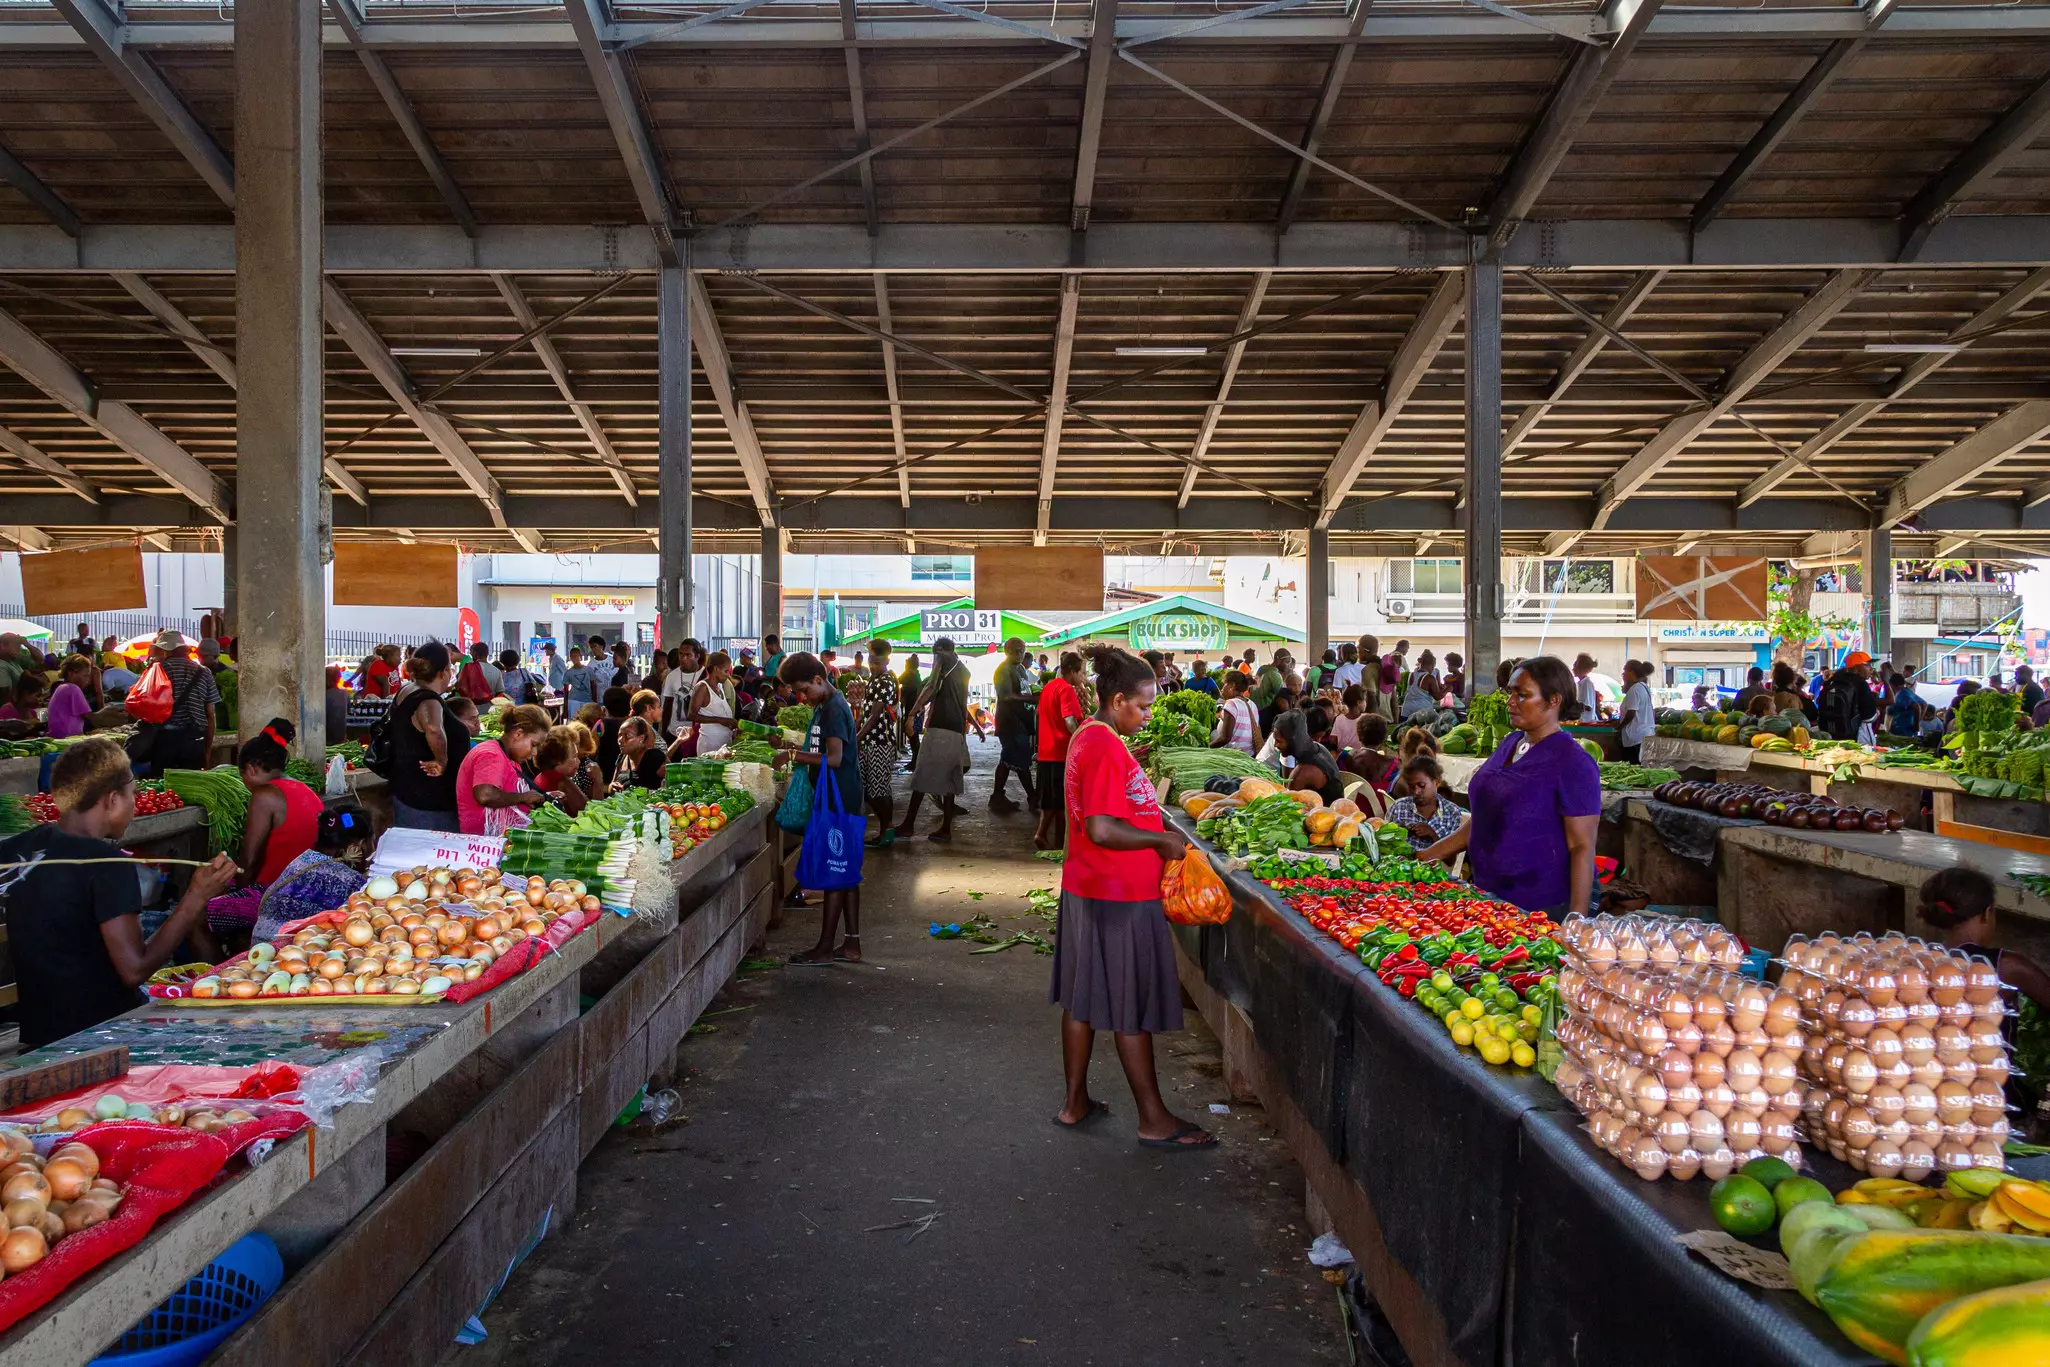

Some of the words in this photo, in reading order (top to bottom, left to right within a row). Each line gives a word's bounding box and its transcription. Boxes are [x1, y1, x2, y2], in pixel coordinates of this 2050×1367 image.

[925, 613, 970, 629] PRO
[979, 613, 996, 628] 31
[974, 632, 996, 642] PRO
[1136, 623, 1177, 637] BULK
[1179, 623, 1221, 637] SHOP
[1663, 625, 1707, 637] CHRISTN
[1708, 629, 1736, 637] SUPER
[1738, 629, 1765, 637] ORE
[432, 847, 459, 862] Ltd.
